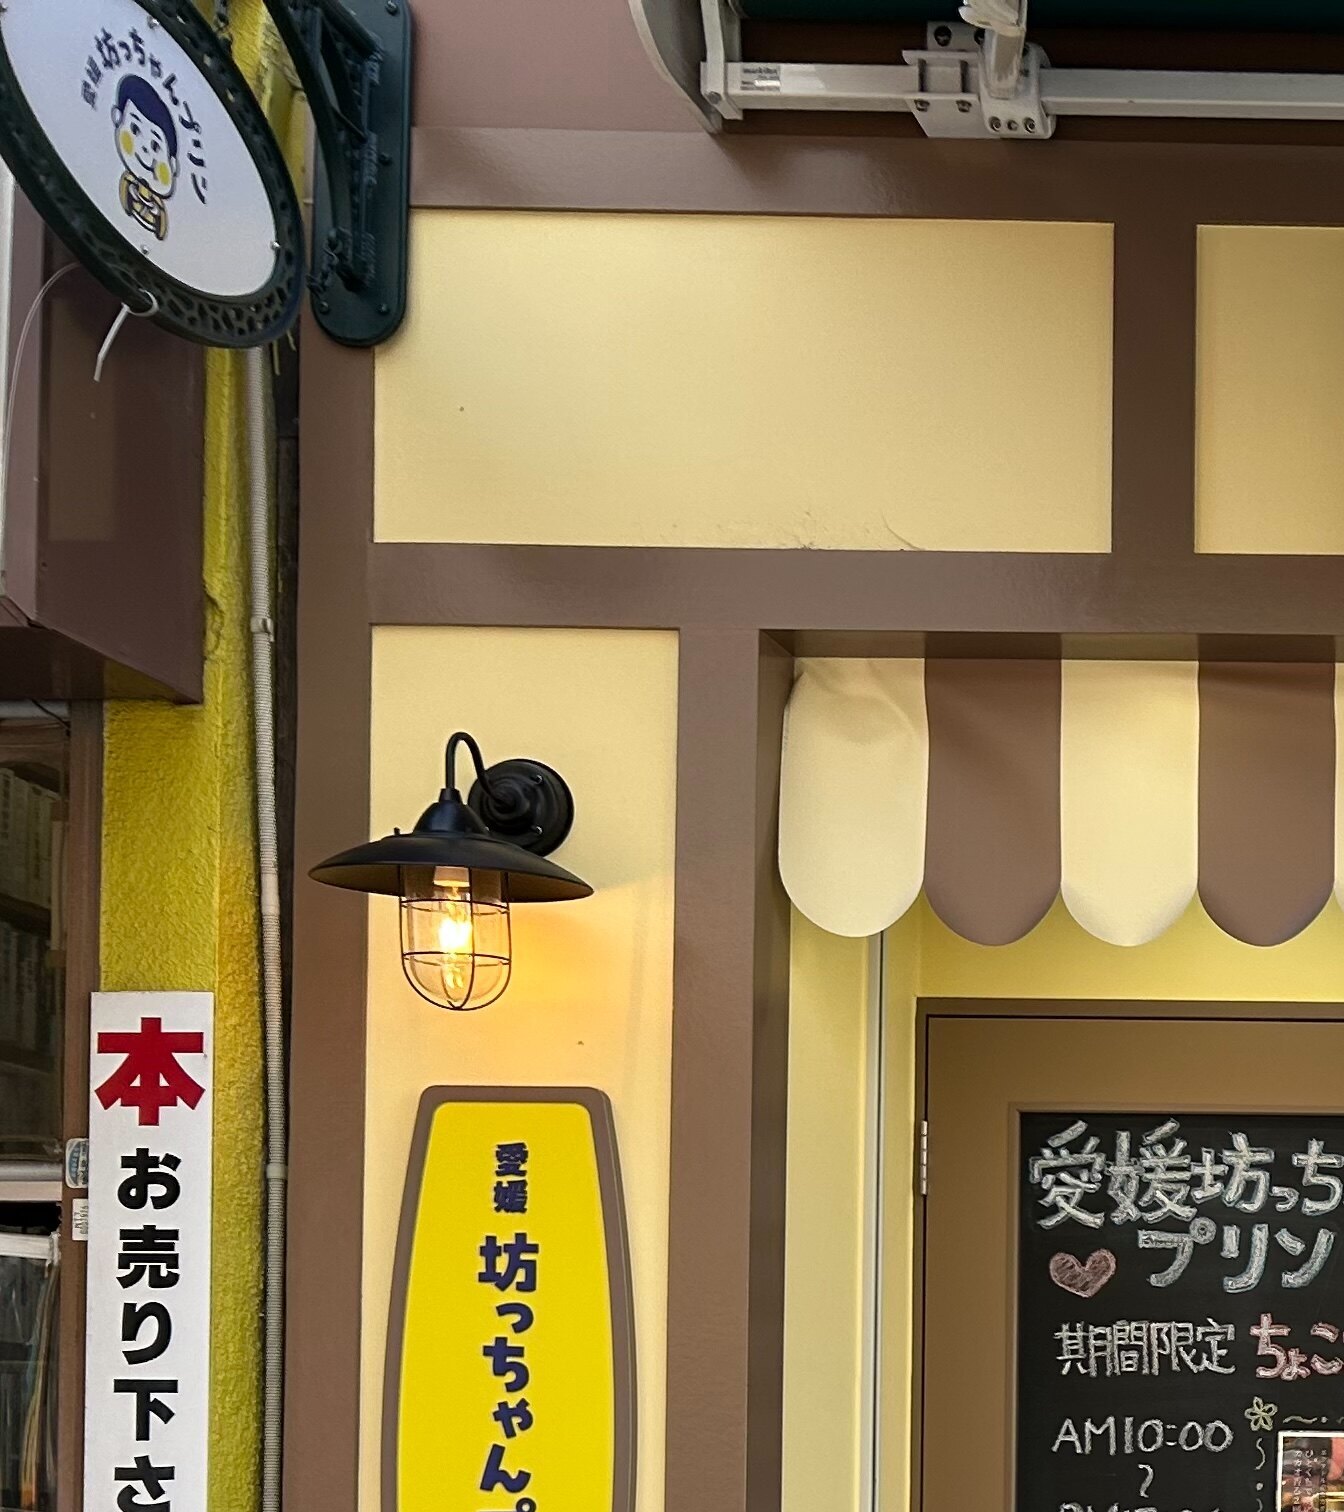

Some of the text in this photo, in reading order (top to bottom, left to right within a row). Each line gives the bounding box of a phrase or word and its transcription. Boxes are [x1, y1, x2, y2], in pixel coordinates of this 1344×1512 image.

[94, 27, 208, 204] 坊っちゃんプリン
[94, 1017, 206, 1126] 本
[495, 1143, 527, 1215] 愛媛
[1138, 1216, 1337, 1294] プリン
[1053, 1318, 1236, 1376] 期間限定
[1052, 1416, 1235, 1456] AM10:00
